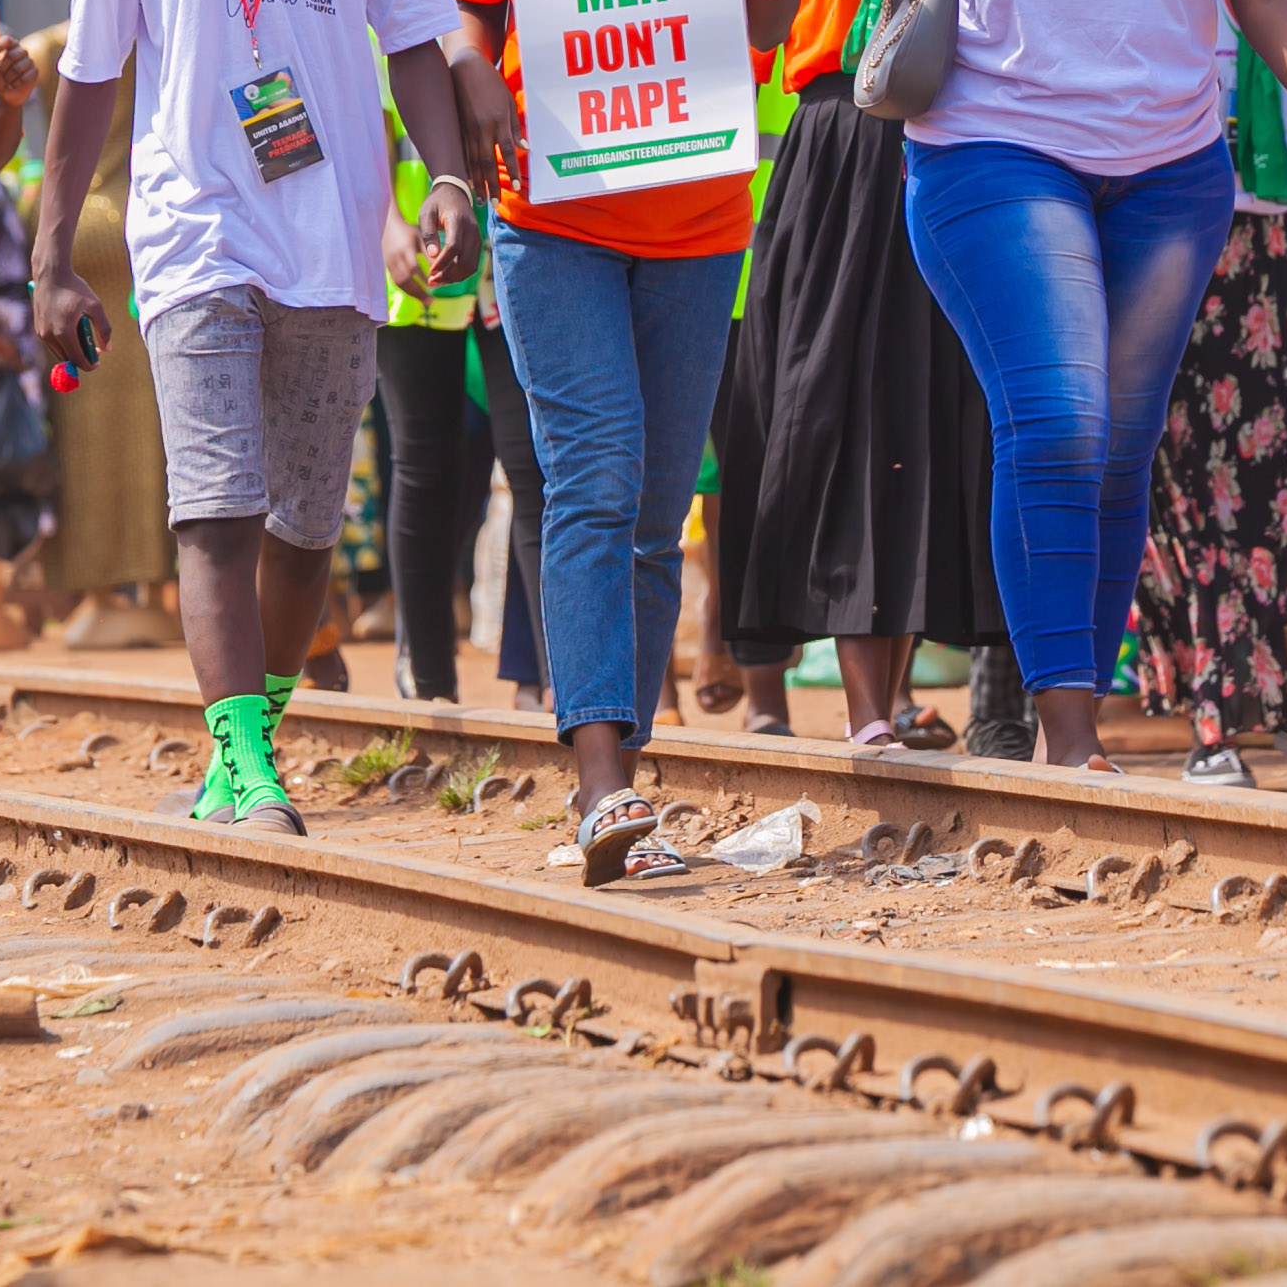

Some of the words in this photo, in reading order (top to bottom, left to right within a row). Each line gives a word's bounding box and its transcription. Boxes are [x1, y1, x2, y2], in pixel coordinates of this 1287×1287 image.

[563, 14, 689, 77] DON'T
[578, 77, 690, 136] RAPE
[252, 123, 279, 140] UNITED
[278, 110, 308, 129] AGAINST
[267, 133, 316, 160] PREGNANCY
[560, 135, 728, 170] #UNITEDAGAINSTTEENAGEPREGNANCY
